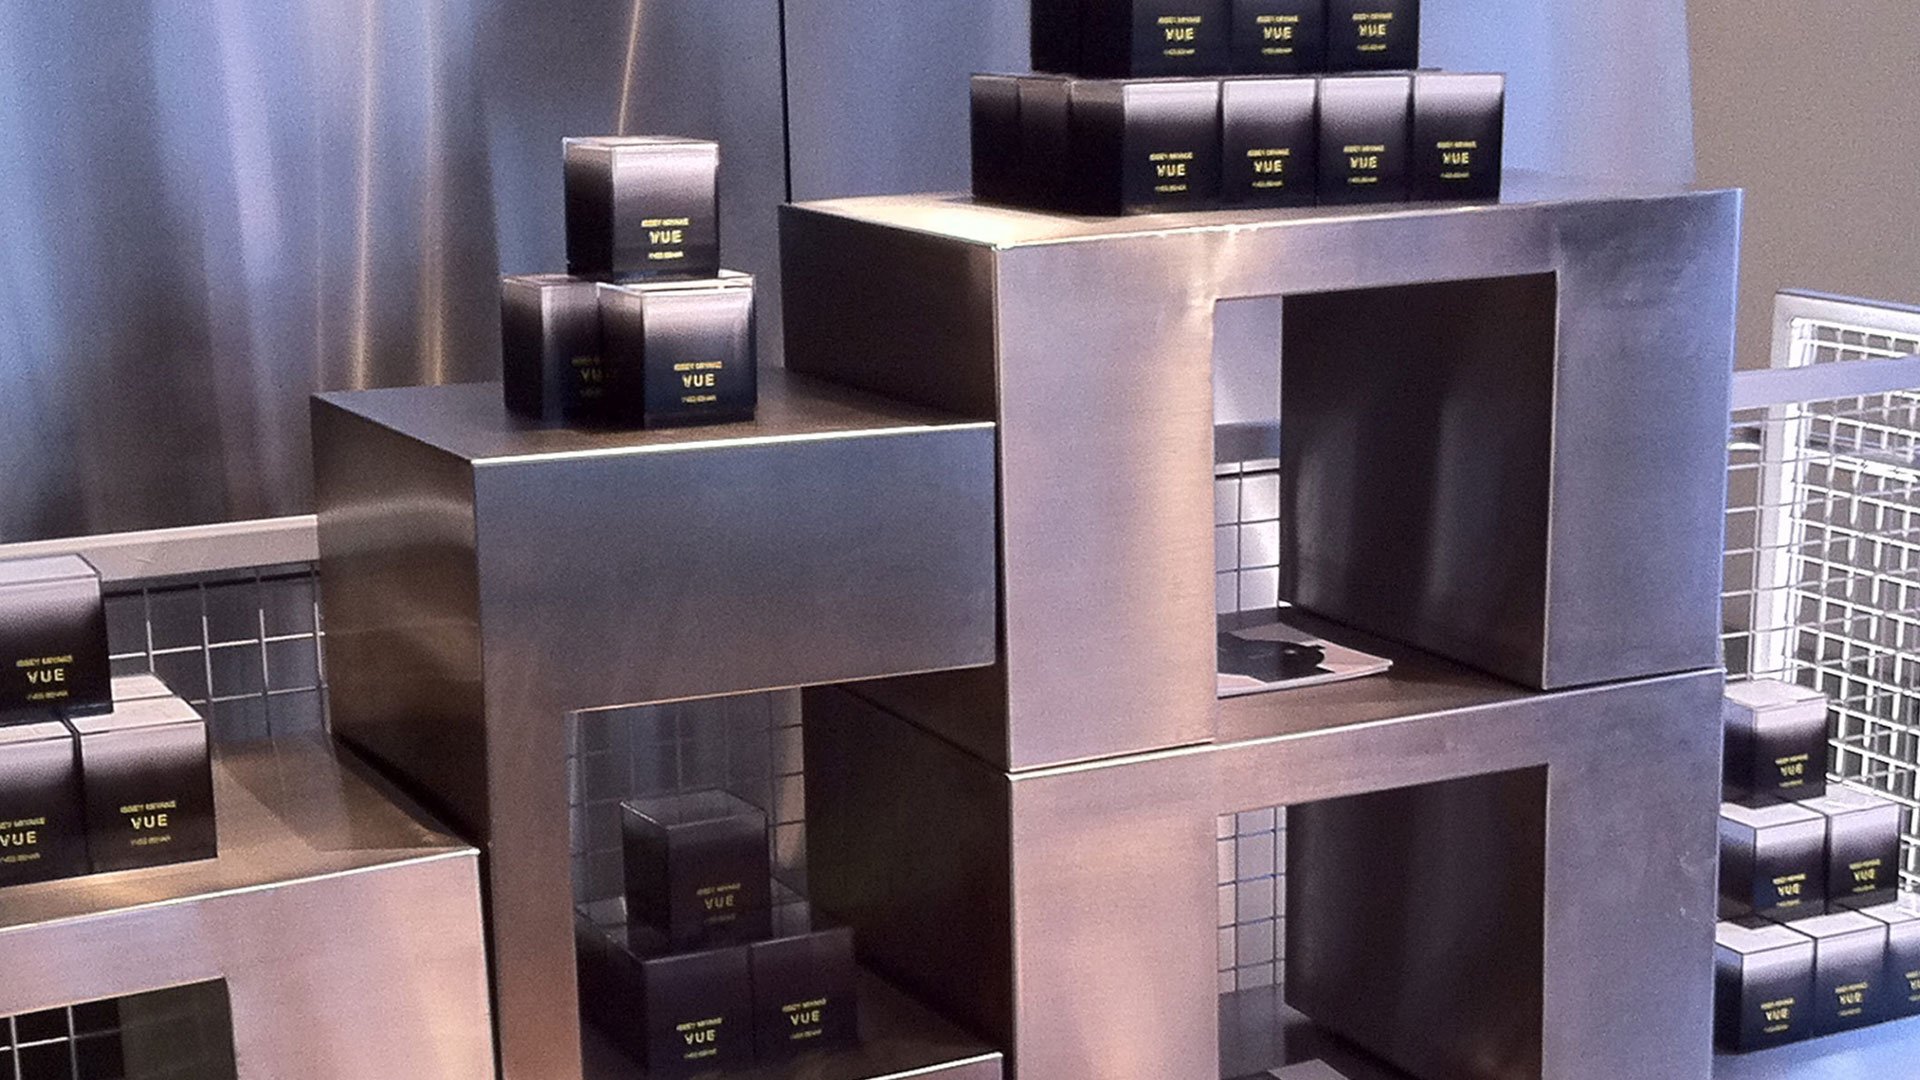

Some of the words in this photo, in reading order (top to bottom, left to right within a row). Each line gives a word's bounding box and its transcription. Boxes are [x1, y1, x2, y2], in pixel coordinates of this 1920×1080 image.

[649, 230, 683, 244] VUE
[682, 373, 716, 388] VUE
[26, 668, 65, 684] VUE
[130, 813, 169, 830] VUE
[0, 831, 37, 847] VUE
[790, 1010, 821, 1026] VUE
[684, 1029, 716, 1045] VUE
